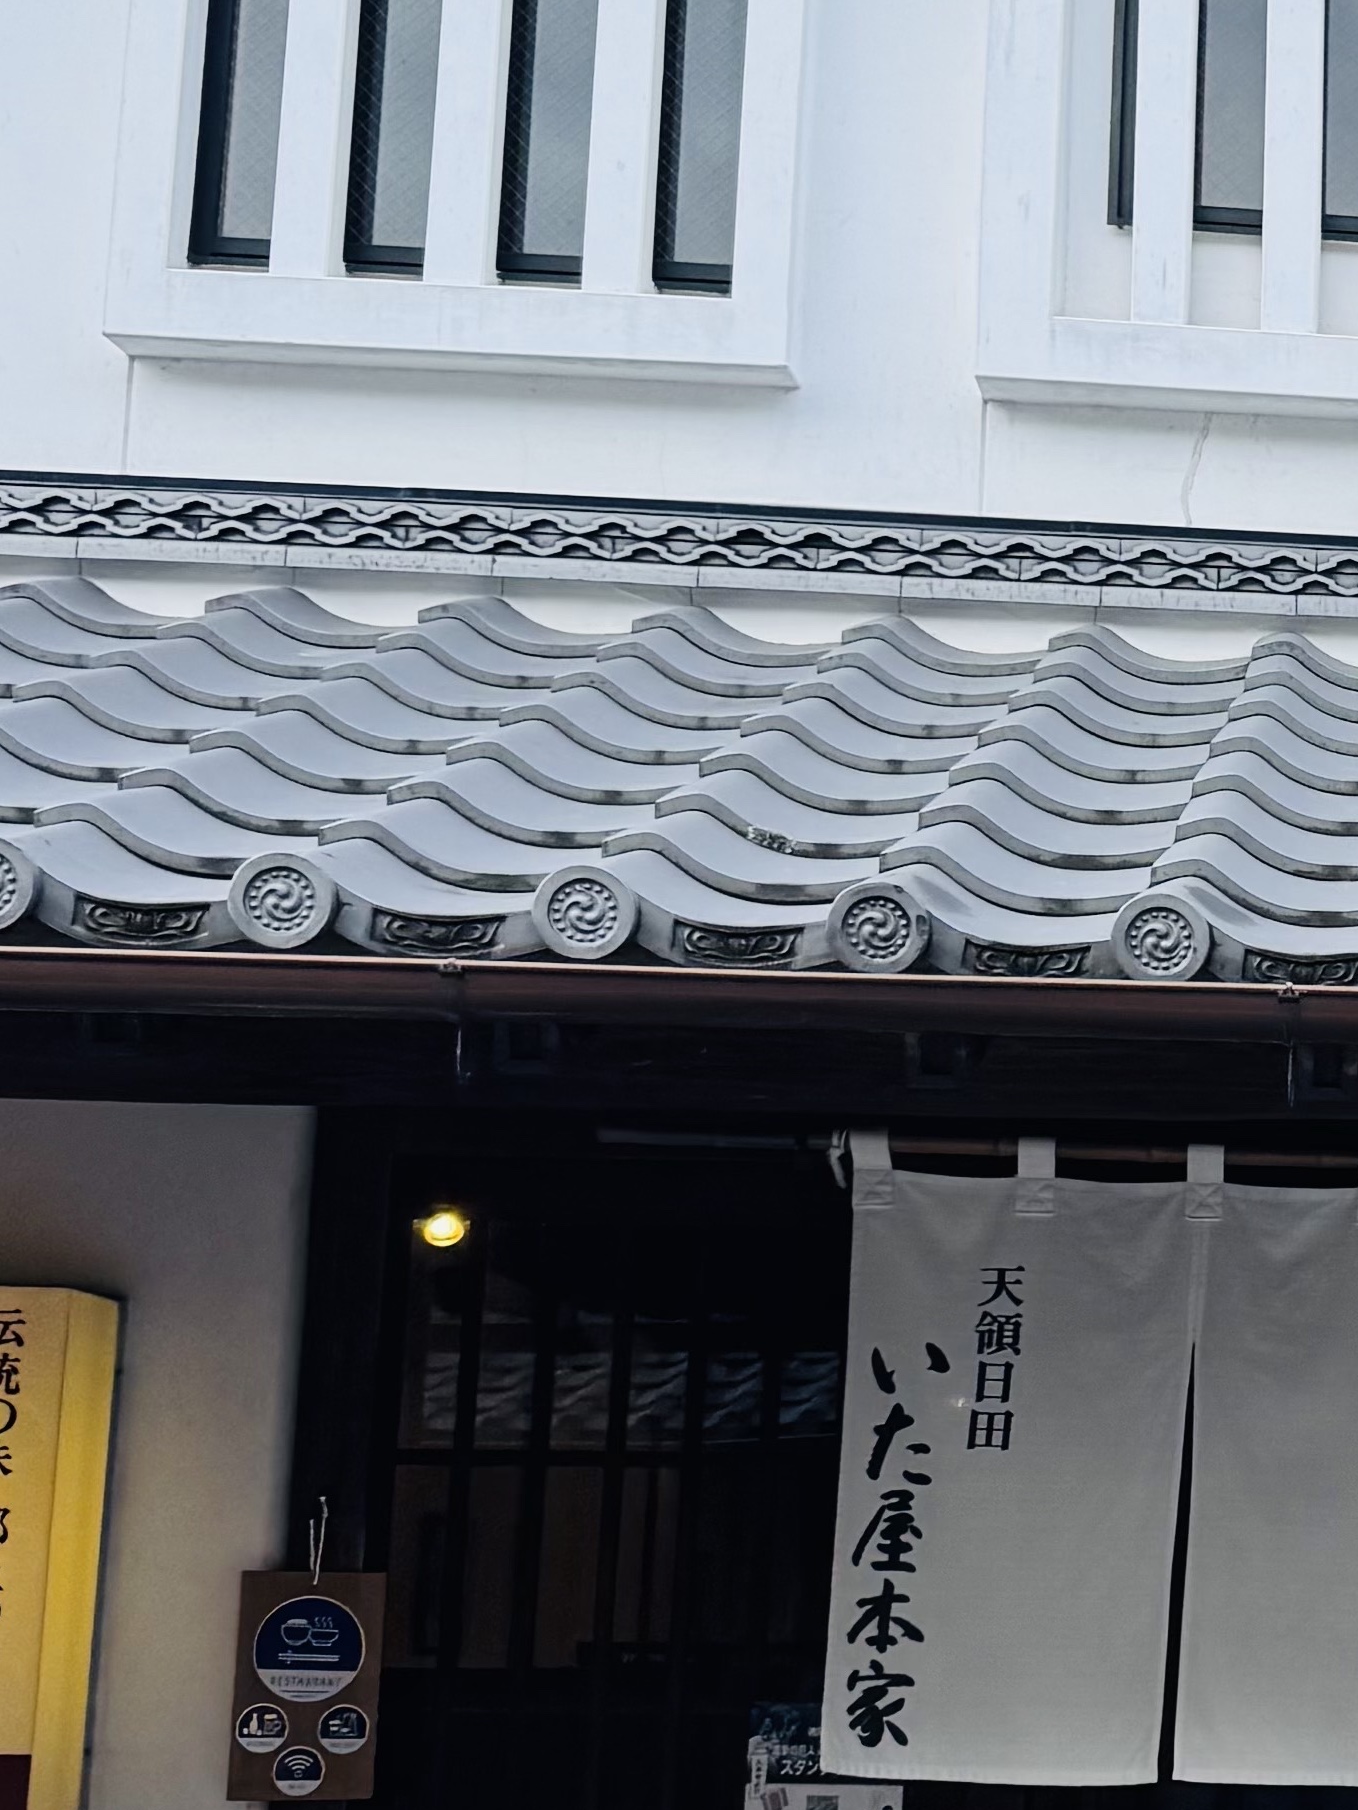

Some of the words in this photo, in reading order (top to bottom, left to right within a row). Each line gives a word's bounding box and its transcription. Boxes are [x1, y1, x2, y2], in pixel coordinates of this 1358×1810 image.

[966, 1265, 1026, 1451] 天領日田
[845, 1341, 951, 1749] いた屋本家
[780, 1759, 826, 1776] スタン
